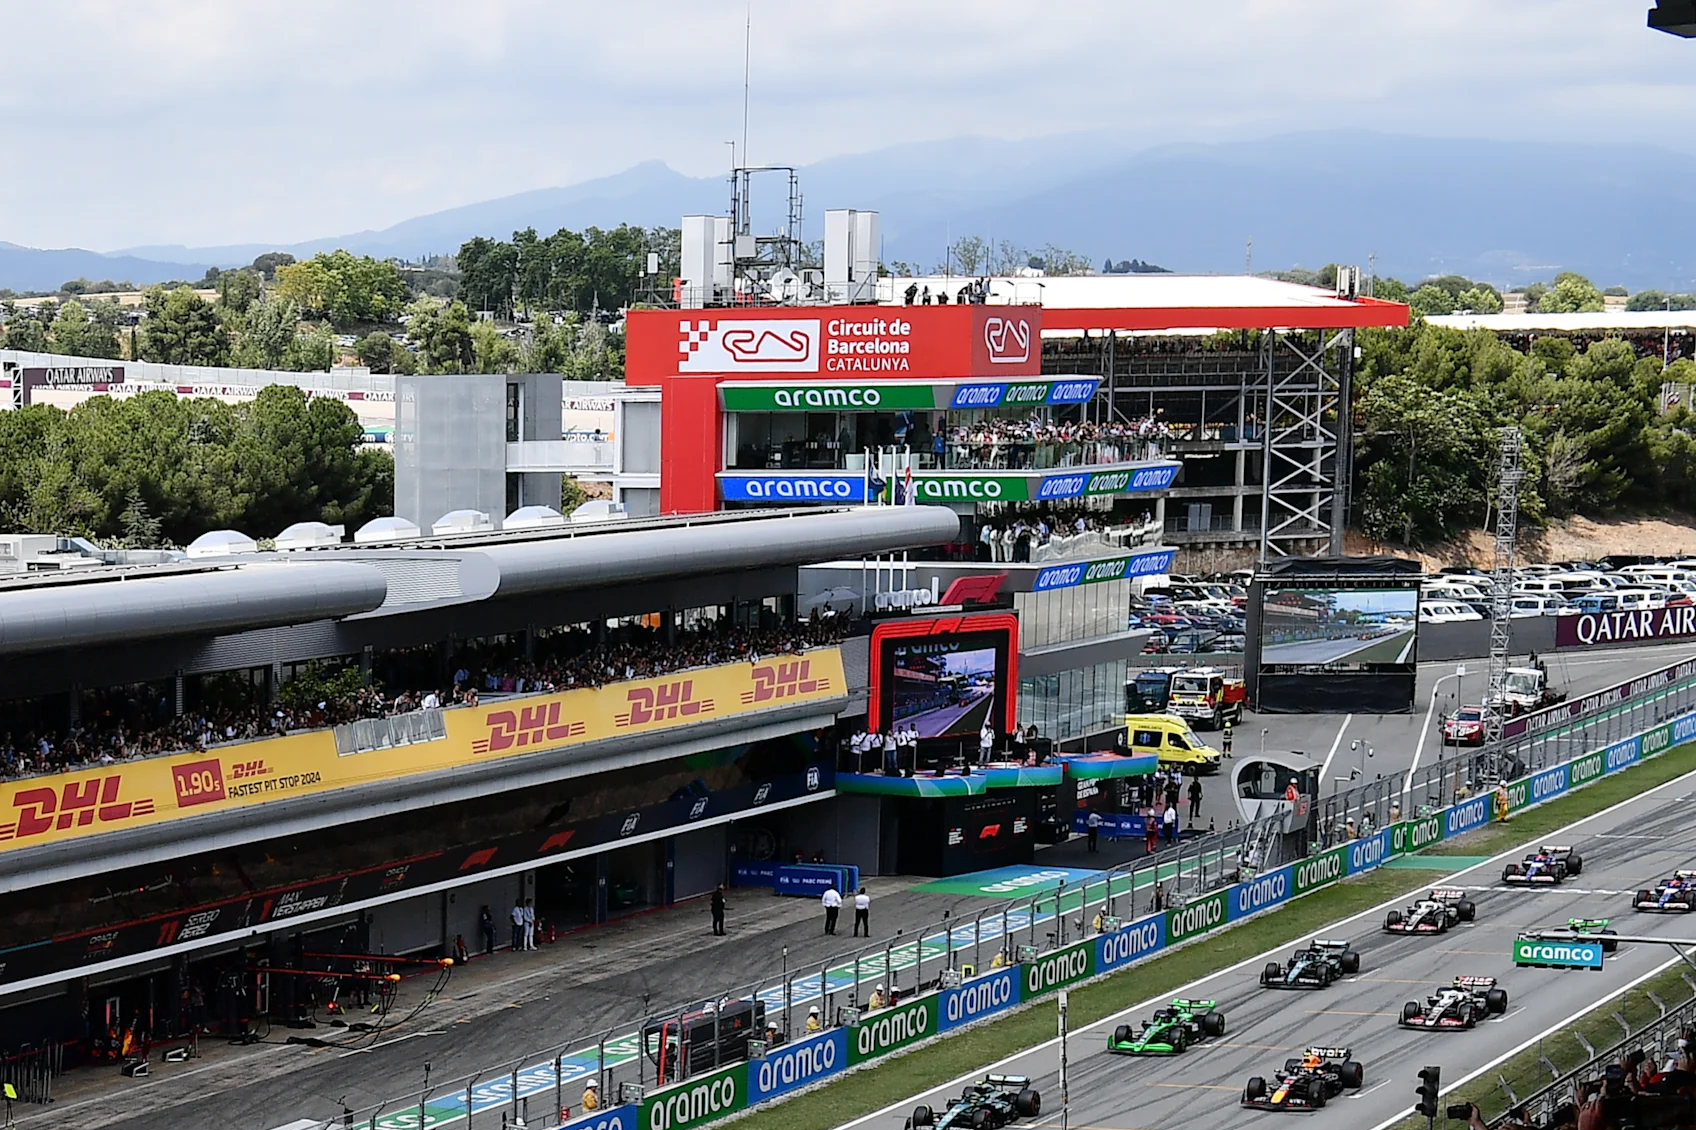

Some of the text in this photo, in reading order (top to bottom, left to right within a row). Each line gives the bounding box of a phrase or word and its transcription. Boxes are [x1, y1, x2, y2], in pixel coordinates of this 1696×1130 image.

[827, 319, 911, 336] Circuit de
[827, 338, 910, 355] Barcelona
[45, 368, 113, 384] QATAR AIRWAYS
[826, 358, 910, 372] CATALUNYA
[108, 384, 137, 393] QATAR
[192, 386, 258, 396] QATAR AIRWAY
[363, 392, 395, 401] QATAR
[774, 388, 881, 406] aramco
[956, 388, 1001, 404] aramco
[1006, 385, 1048, 402] aramco
[1052, 383, 1093, 399] aramco
[746, 479, 851, 497] aramco
[912, 480, 1002, 498] ramco
[1041, 478, 1084, 496] aramco
[1088, 473, 1129, 491] aramco
[1133, 469, 1173, 487] aramco
[1086, 560, 1126, 580] aramco
[1130, 553, 1169, 574] aramco
[1039, 565, 1080, 588] aramco
[875, 589, 932, 608] aramco
[1577, 607, 1696, 644] QATAR AIR
[751, 660, 817, 702] DHL
[628, 680, 700, 724] DHL
[486, 702, 570, 751] DHL
[1675, 716, 1696, 740] aramc
[1643, 728, 1668, 754] aramco
[1608, 742, 1636, 769] aramco
[232, 760, 267, 779] DHL
[1572, 756, 1601, 783] aramco
[228, 771, 322, 799] FASTEST PIT STOP 2024
[1533, 770, 1564, 798] aramco
[13, 775, 132, 837] DHL
[1449, 801, 1484, 831] aramco
[1298, 853, 1340, 889] aramco
[1239, 874, 1285, 911] aramco
[272, 896, 329, 918] VERSTAPPEN
[1172, 898, 1222, 937] aramco
[89, 931, 120, 946] ORACLE
[157, 920, 180, 946] 11
[1103, 922, 1157, 965] aramco
[1520, 943, 1596, 963] aramco
[1029, 947, 1087, 992] aramco
[947, 975, 1011, 1022] aramco
[858, 1005, 928, 1056] aramco
[759, 1039, 835, 1093] aramco
